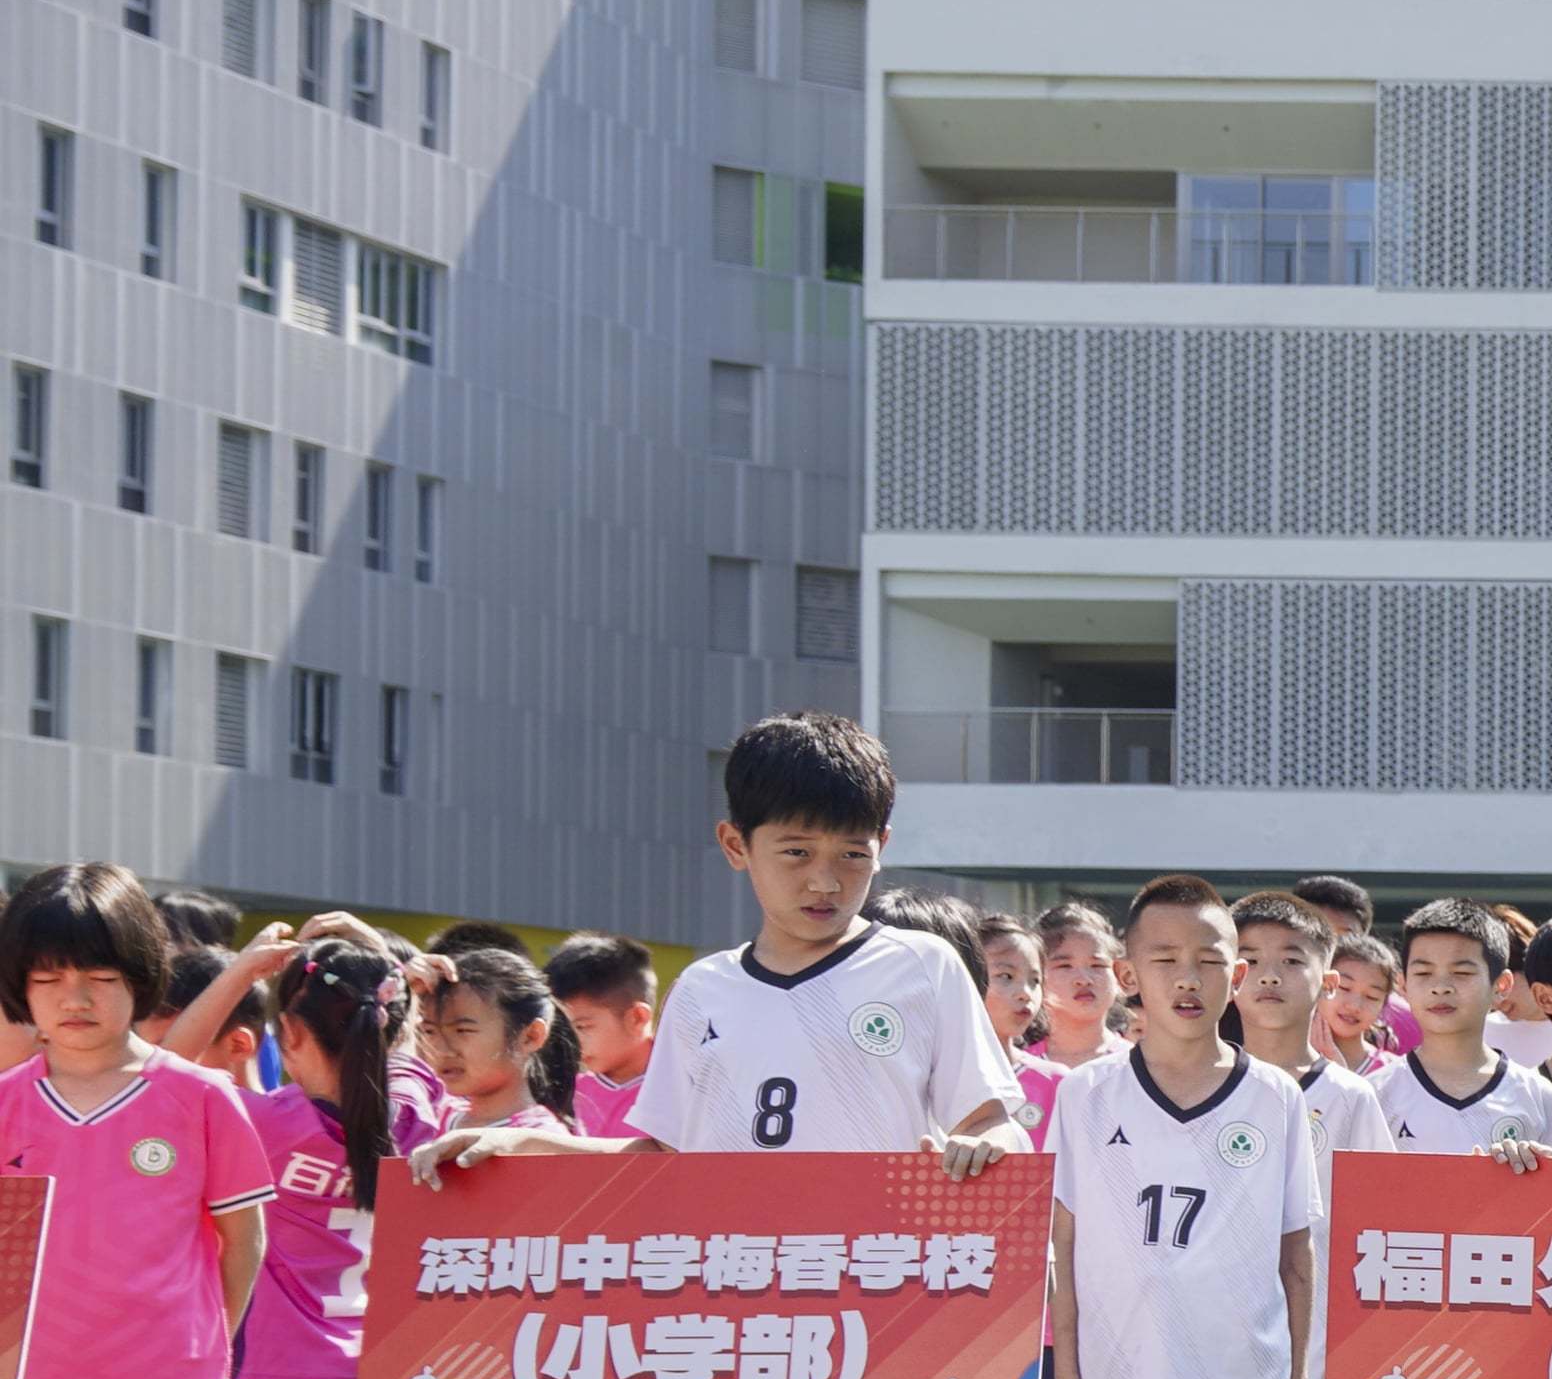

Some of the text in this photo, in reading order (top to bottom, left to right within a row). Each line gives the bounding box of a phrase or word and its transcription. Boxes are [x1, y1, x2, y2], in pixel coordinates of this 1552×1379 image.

[751, 1077, 797, 1149] 8
[1136, 1184, 1207, 1250] 17
[416, 1233, 997, 1296] 深圳中学梅香学校
